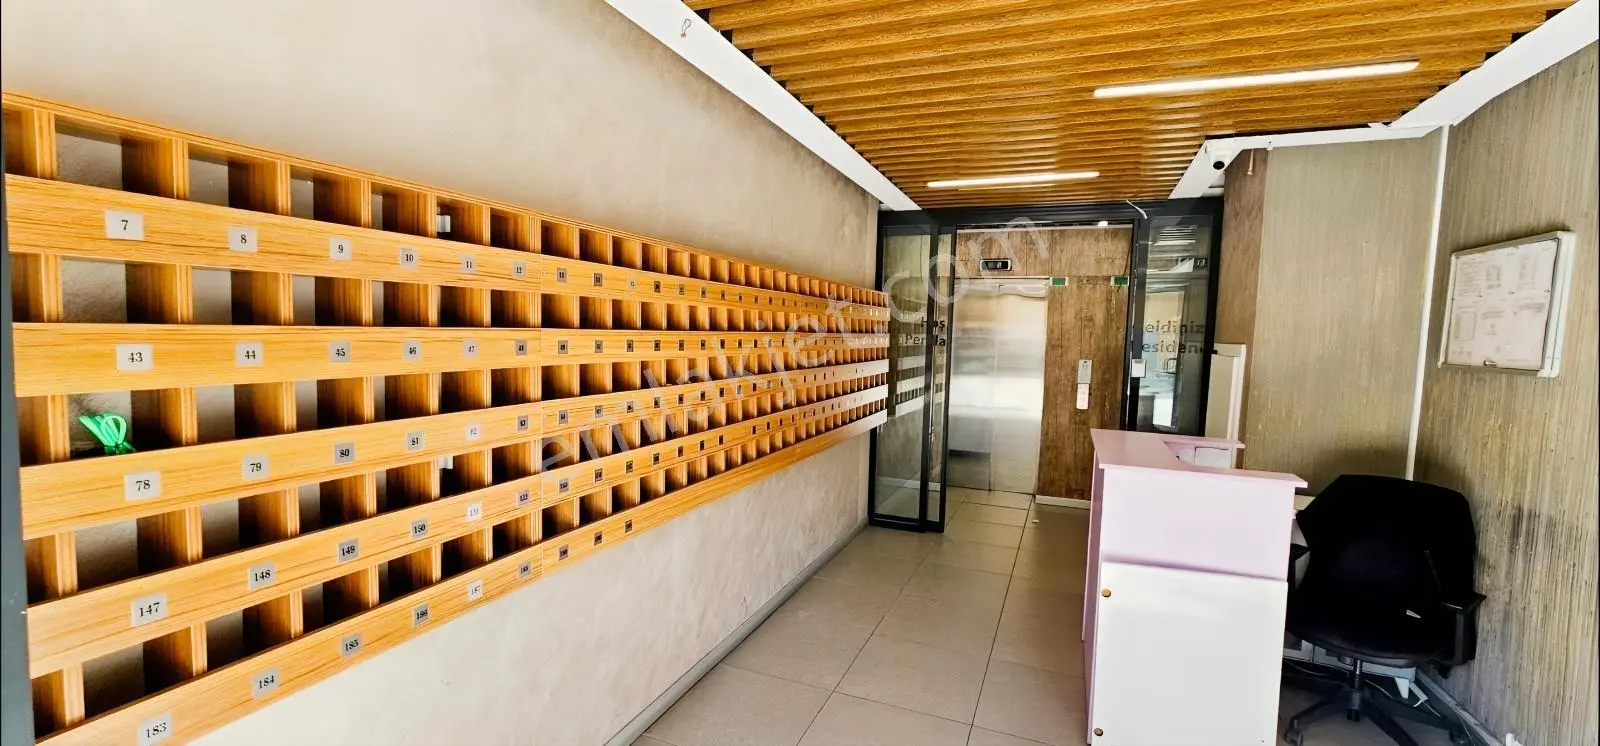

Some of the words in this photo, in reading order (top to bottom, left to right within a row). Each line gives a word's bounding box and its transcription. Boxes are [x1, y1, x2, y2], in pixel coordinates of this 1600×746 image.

[1145, 320, 1204, 334] eldiniz
[127, 351, 143, 363] 43
[244, 350, 256, 360] 44
[335, 348, 346, 357] 45
[339, 448, 350, 458] 80
[249, 462, 262, 473] 79
[135, 479, 151, 491] 78
[413, 523, 426, 534] 150
[341, 545, 356, 557] 149
[254, 569, 271, 582] 148
[139, 601, 160, 617] 147
[345, 639, 359, 652] 185
[259, 674, 275, 689] 184
[146, 722, 167, 739] 183
